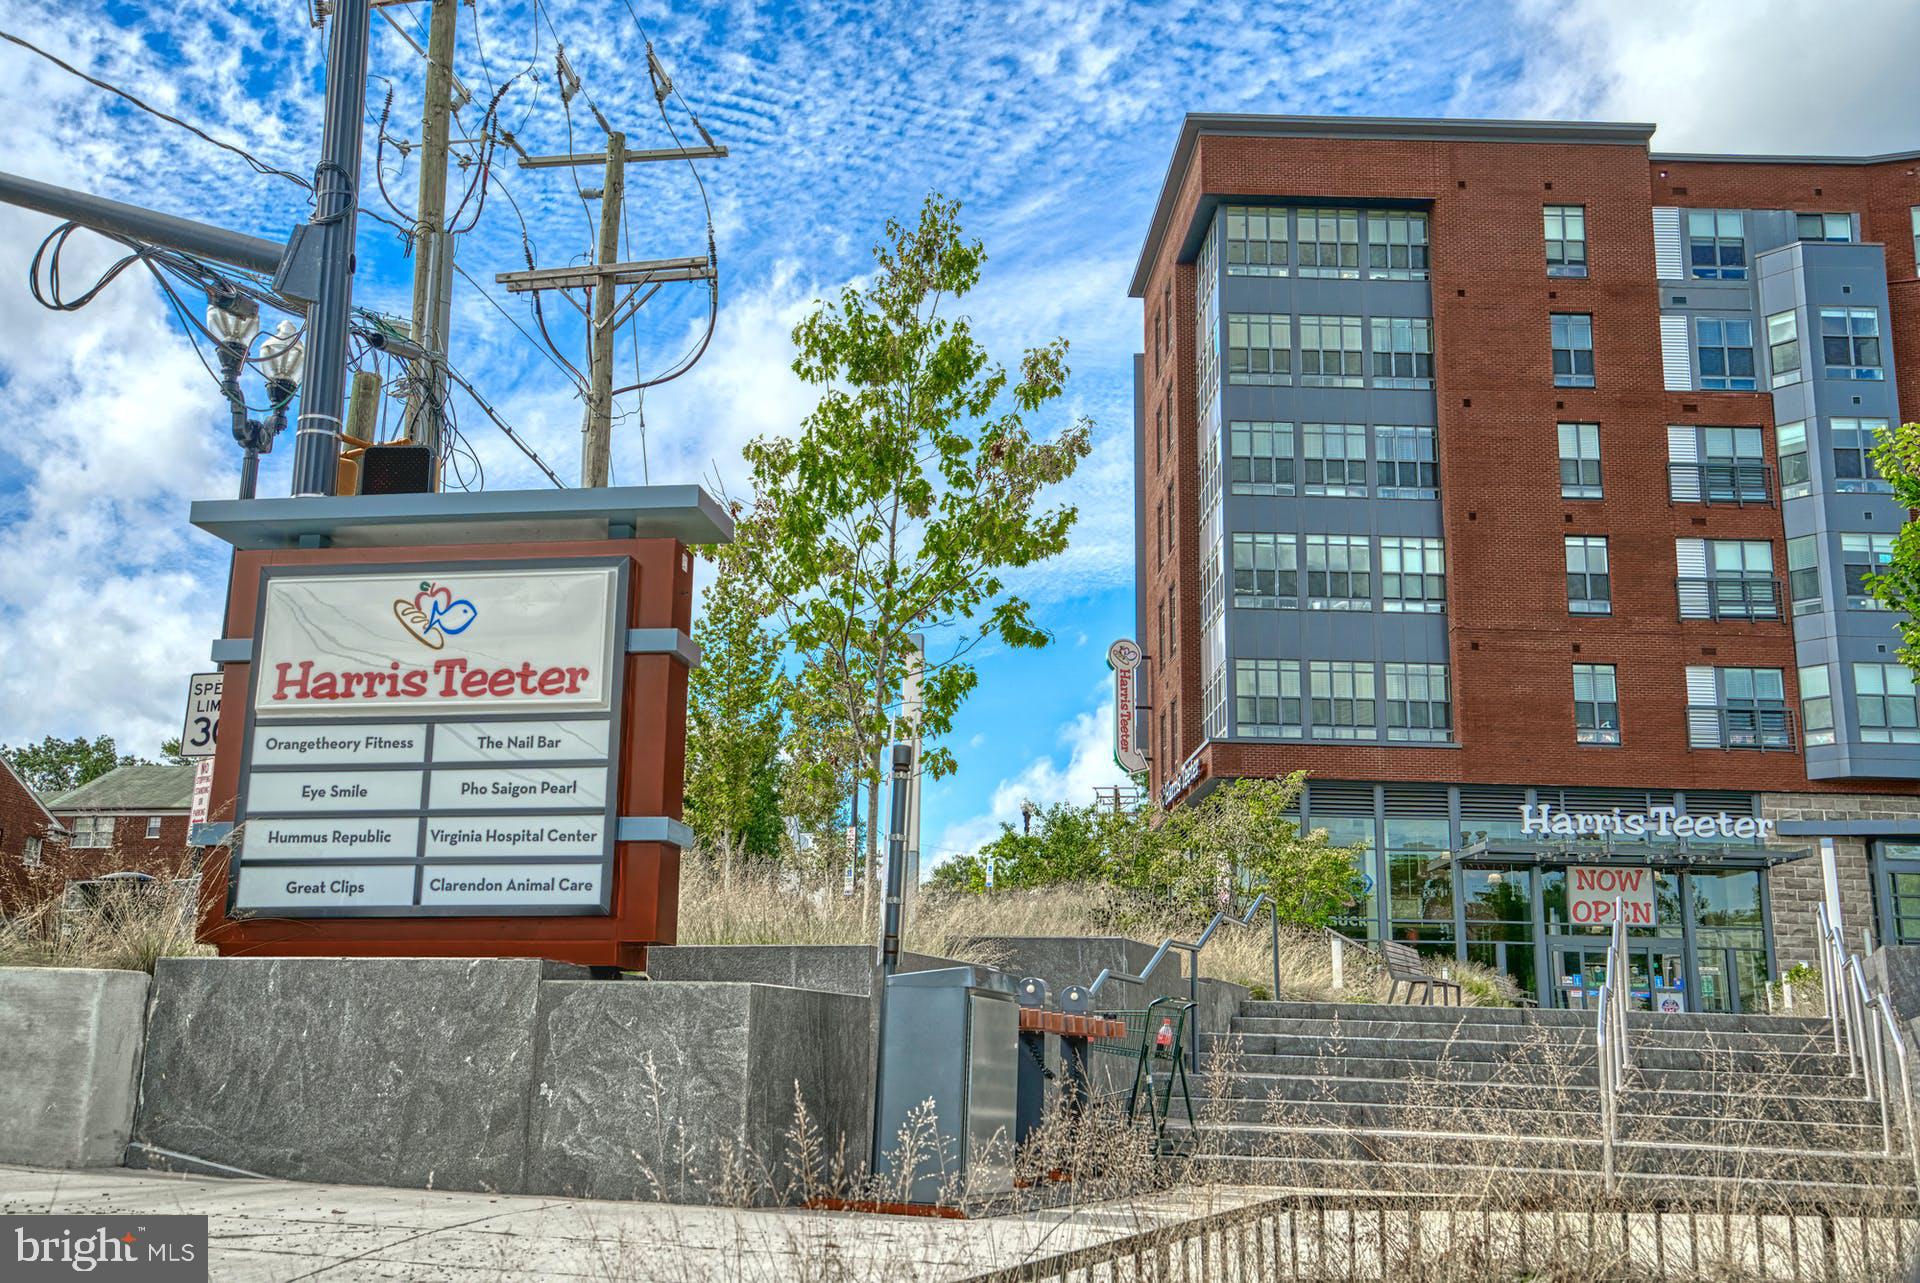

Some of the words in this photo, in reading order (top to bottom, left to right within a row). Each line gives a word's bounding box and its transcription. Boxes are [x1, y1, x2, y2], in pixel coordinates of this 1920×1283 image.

[272, 661, 429, 700] Harris
[433, 658, 589, 698] Teeter
[194, 682, 223, 696] SPE
[1119, 668, 1131, 711] Harris
[196, 700, 221, 713] LIM
[1119, 711, 1131, 752] Teeter
[265, 736, 361, 753] Orangetheory
[365, 736, 414, 749] Fitness
[477, 735, 504, 749] The
[507, 735, 534, 749] Nail
[537, 735, 561, 749] Bar
[301, 785, 326, 801] Eye
[330, 784, 368, 798] Smile
[461, 781, 488, 795] Pho
[491, 781, 537, 798] Saigon
[540, 780, 577, 794] Pearl
[1519, 803, 1647, 835] Harris
[1650, 806, 1774, 838] Teeter
[268, 830, 328, 844] Hummus
[332, 829, 392, 847] Republic
[430, 829, 482, 846] Virginia
[486, 828, 544, 846] Hospital
[547, 828, 598, 842] Center
[285, 880, 326, 895] Great
[329, 879, 365, 897] Clips
[429, 877, 503, 892] Clarendon
[506, 877, 555, 892] Animal
[558, 878, 593, 892] Care
[1576, 868, 1643, 892] NOW
[1571, 900, 1652, 924] OPEN
